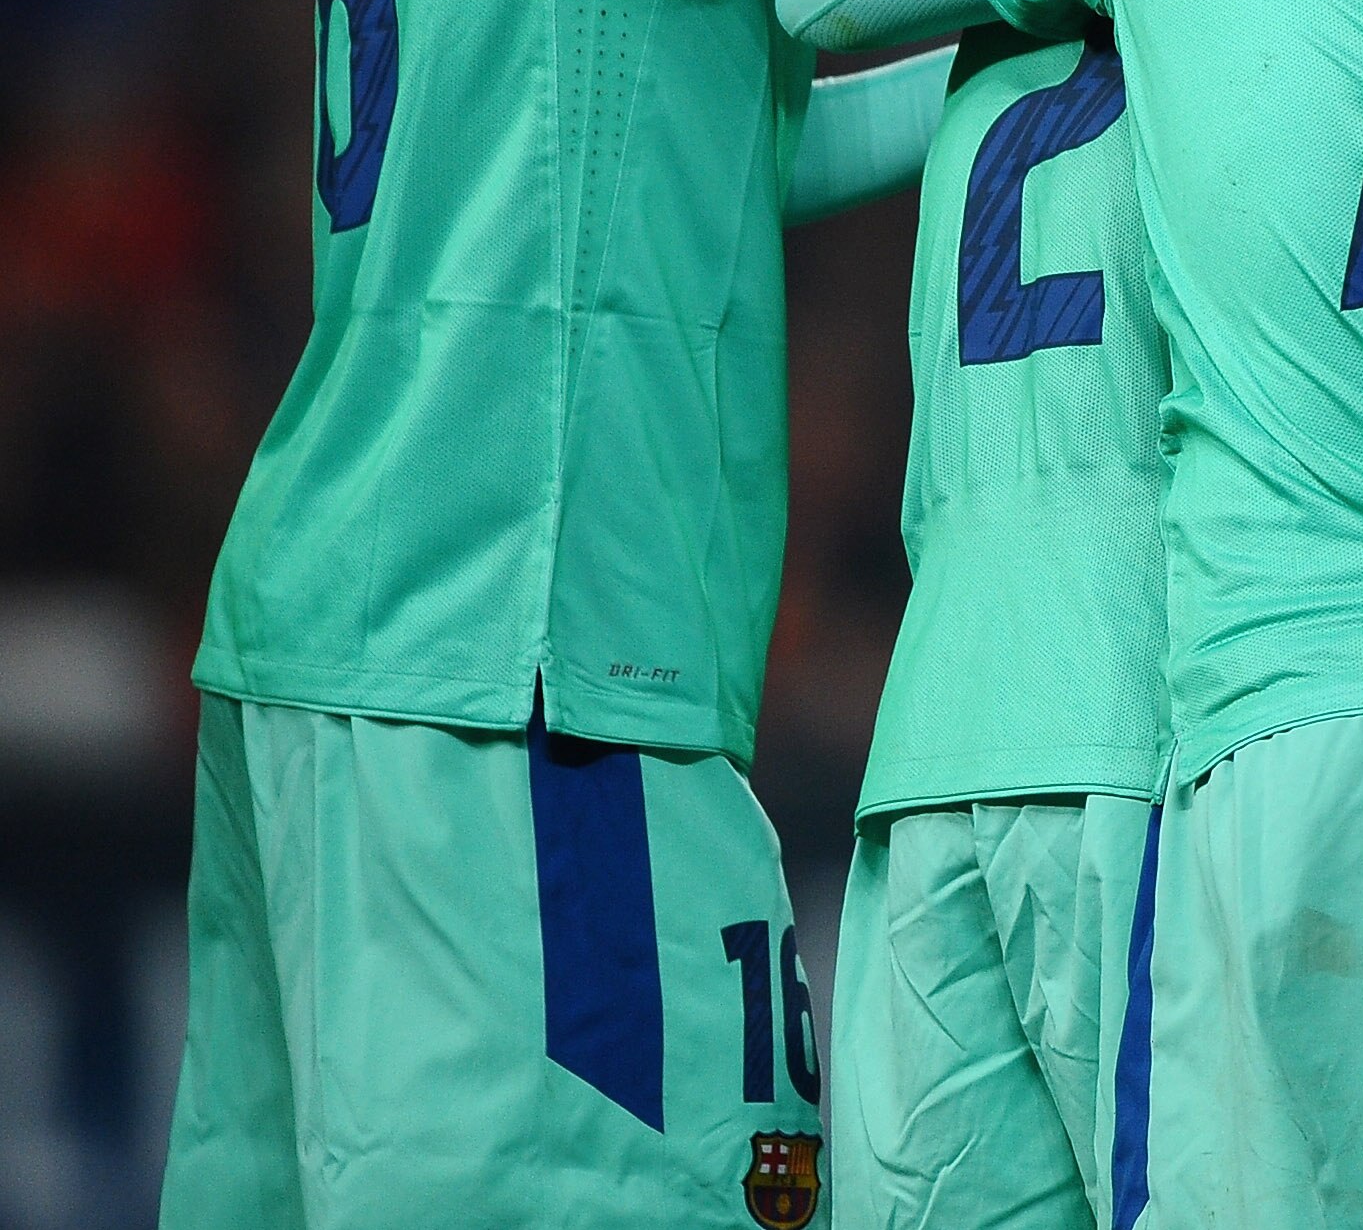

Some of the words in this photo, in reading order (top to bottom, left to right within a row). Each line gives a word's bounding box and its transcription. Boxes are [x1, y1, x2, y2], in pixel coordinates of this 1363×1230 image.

[957, 45, 1128, 368] 2
[608, 662, 681, 684] DRI-FIT
[719, 919, 823, 1106] 16
